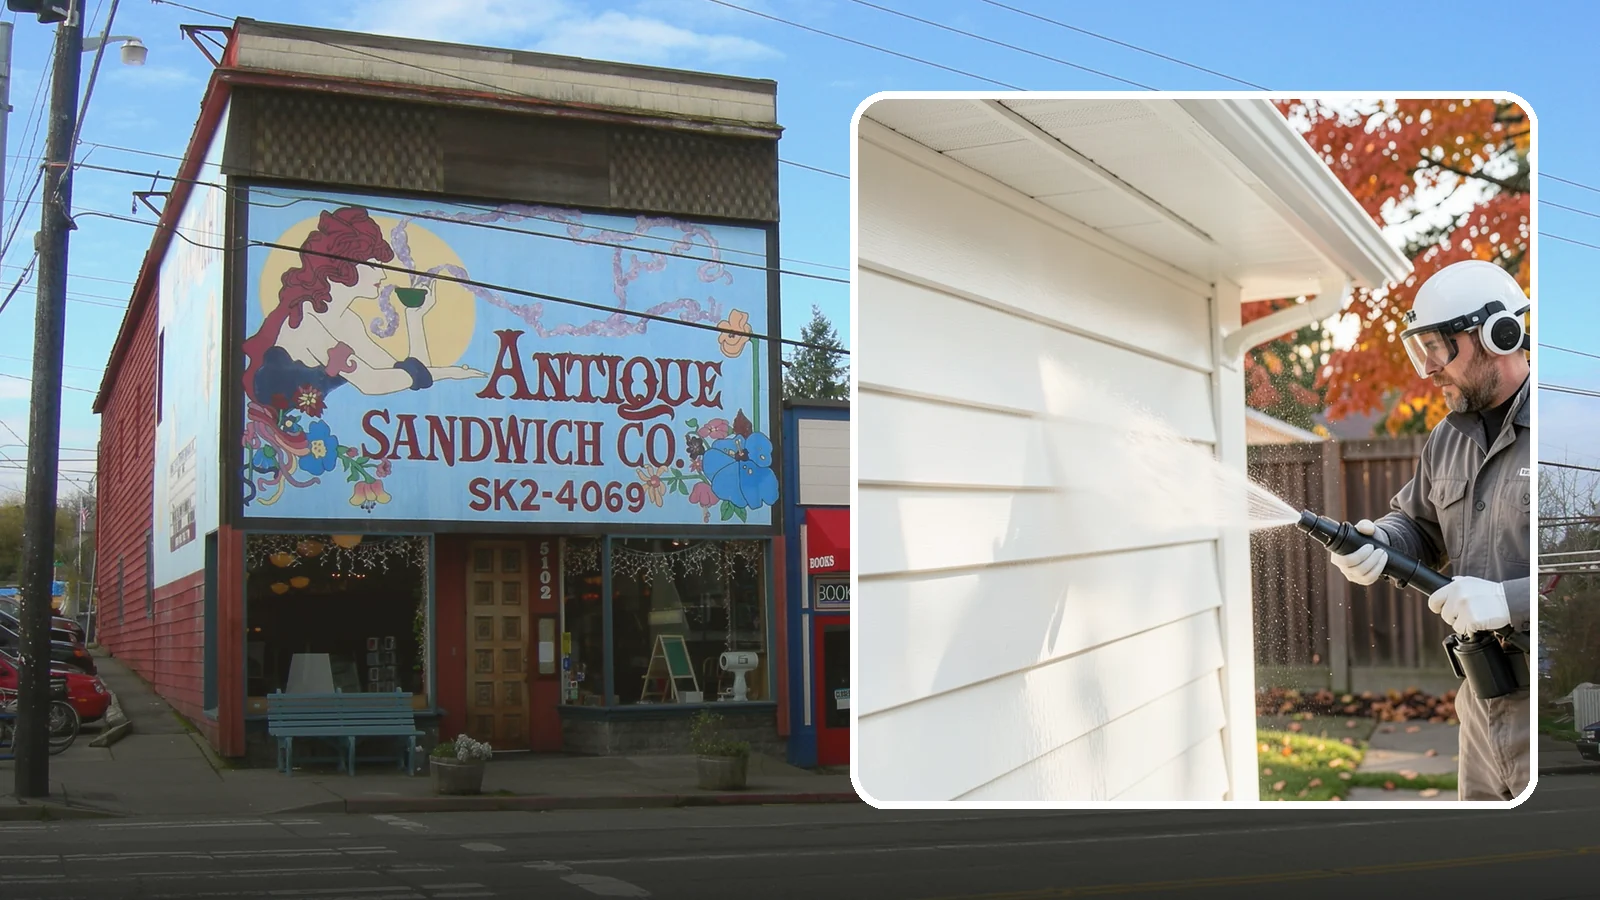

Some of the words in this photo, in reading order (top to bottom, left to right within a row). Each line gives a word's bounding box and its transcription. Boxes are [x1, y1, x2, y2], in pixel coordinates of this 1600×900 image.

[476, 329, 723, 420] ANTIQUE
[361, 409, 604, 467] SANDWICH
[617, 422, 685, 468] CO.
[468, 477, 645, 513] SK2-4069
[539, 541, 552, 600] 5102
[809, 555, 835, 569] BOOKS
